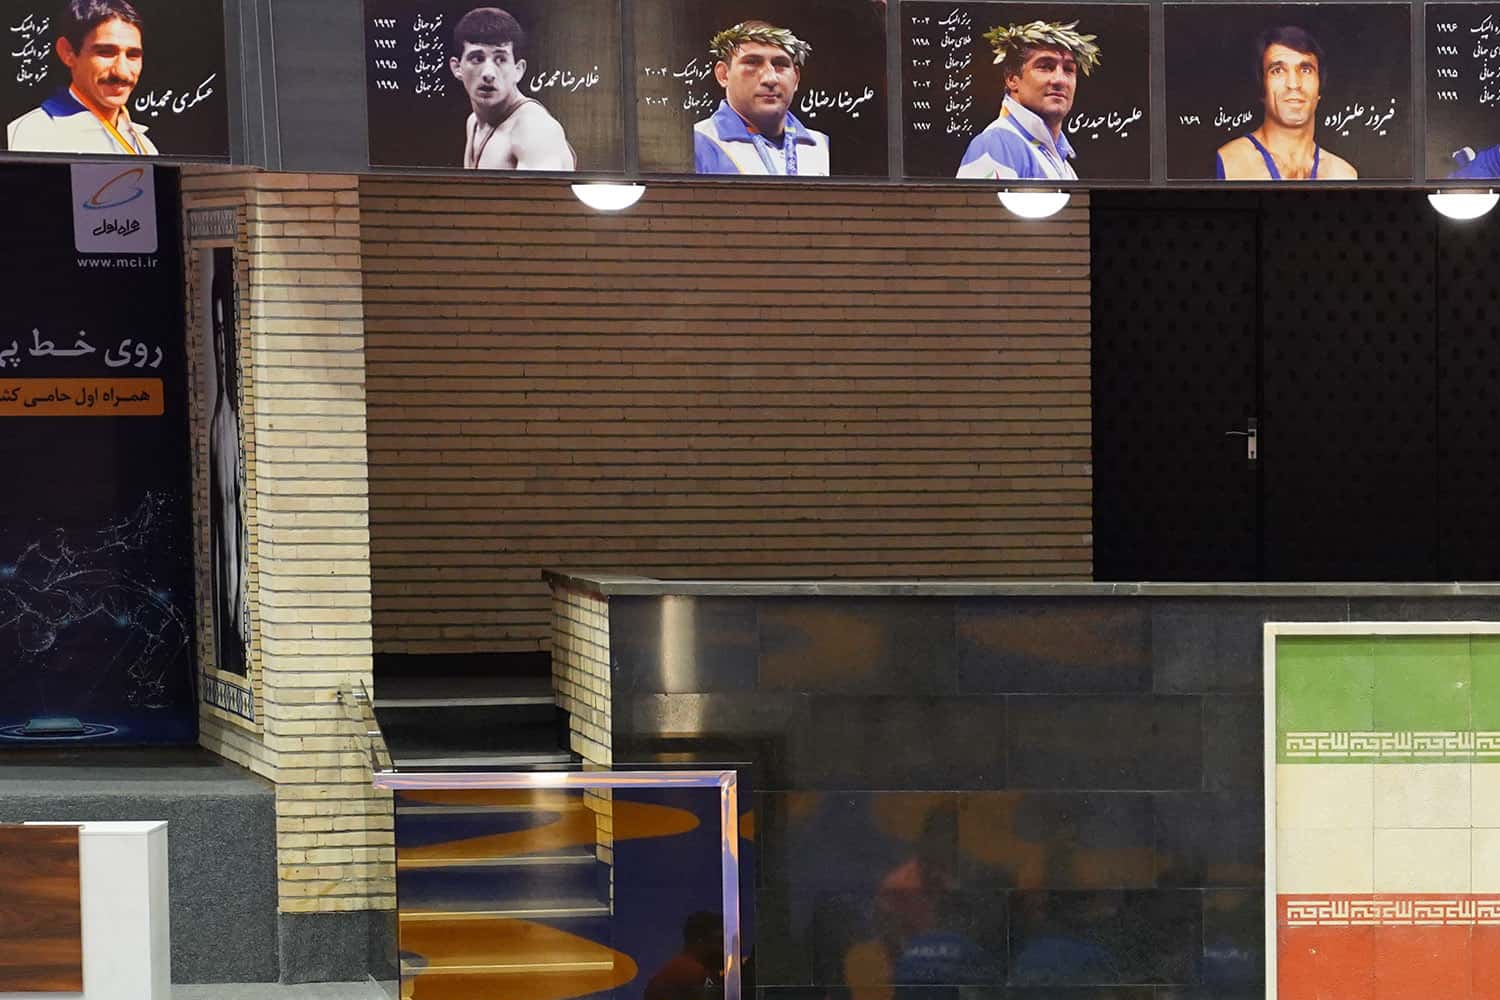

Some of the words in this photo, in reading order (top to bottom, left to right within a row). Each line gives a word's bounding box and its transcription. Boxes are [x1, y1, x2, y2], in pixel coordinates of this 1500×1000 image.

[374, 19, 397, 28] ۱۹۹۳
[1436, 46, 1458, 55] ۱۹۹۸
[375, 59, 398, 69] ۱۹۹۵
[1436, 68, 1458, 77] ۱۹۹۵
[376, 80, 400, 89] ۱۹۹۸
[530, 70, 560, 92] محمدی
[134, 89, 173, 117] محمدیان
[172, 72, 217, 113] عسکری
[838, 81, 875, 118] علیرضا
[1436, 91, 1458, 100] ۱۹۹۹
[913, 122, 931, 130] ۱۹۹۷
[1067, 113, 1106, 139] حیدری
[1107, 107, 1142, 138] علیرضا
[1324, 103, 1365, 136] علیزاده
[1364, 98, 1395, 136] فیروز
[77, 256, 159, 268] www.mci.ir
[28, 328, 97, 357] خط
[104, 338, 163, 368] روی
[23, 387, 71, 408] حامی
[75, 387, 98, 408] اول
[103, 387, 150, 407] همراه
